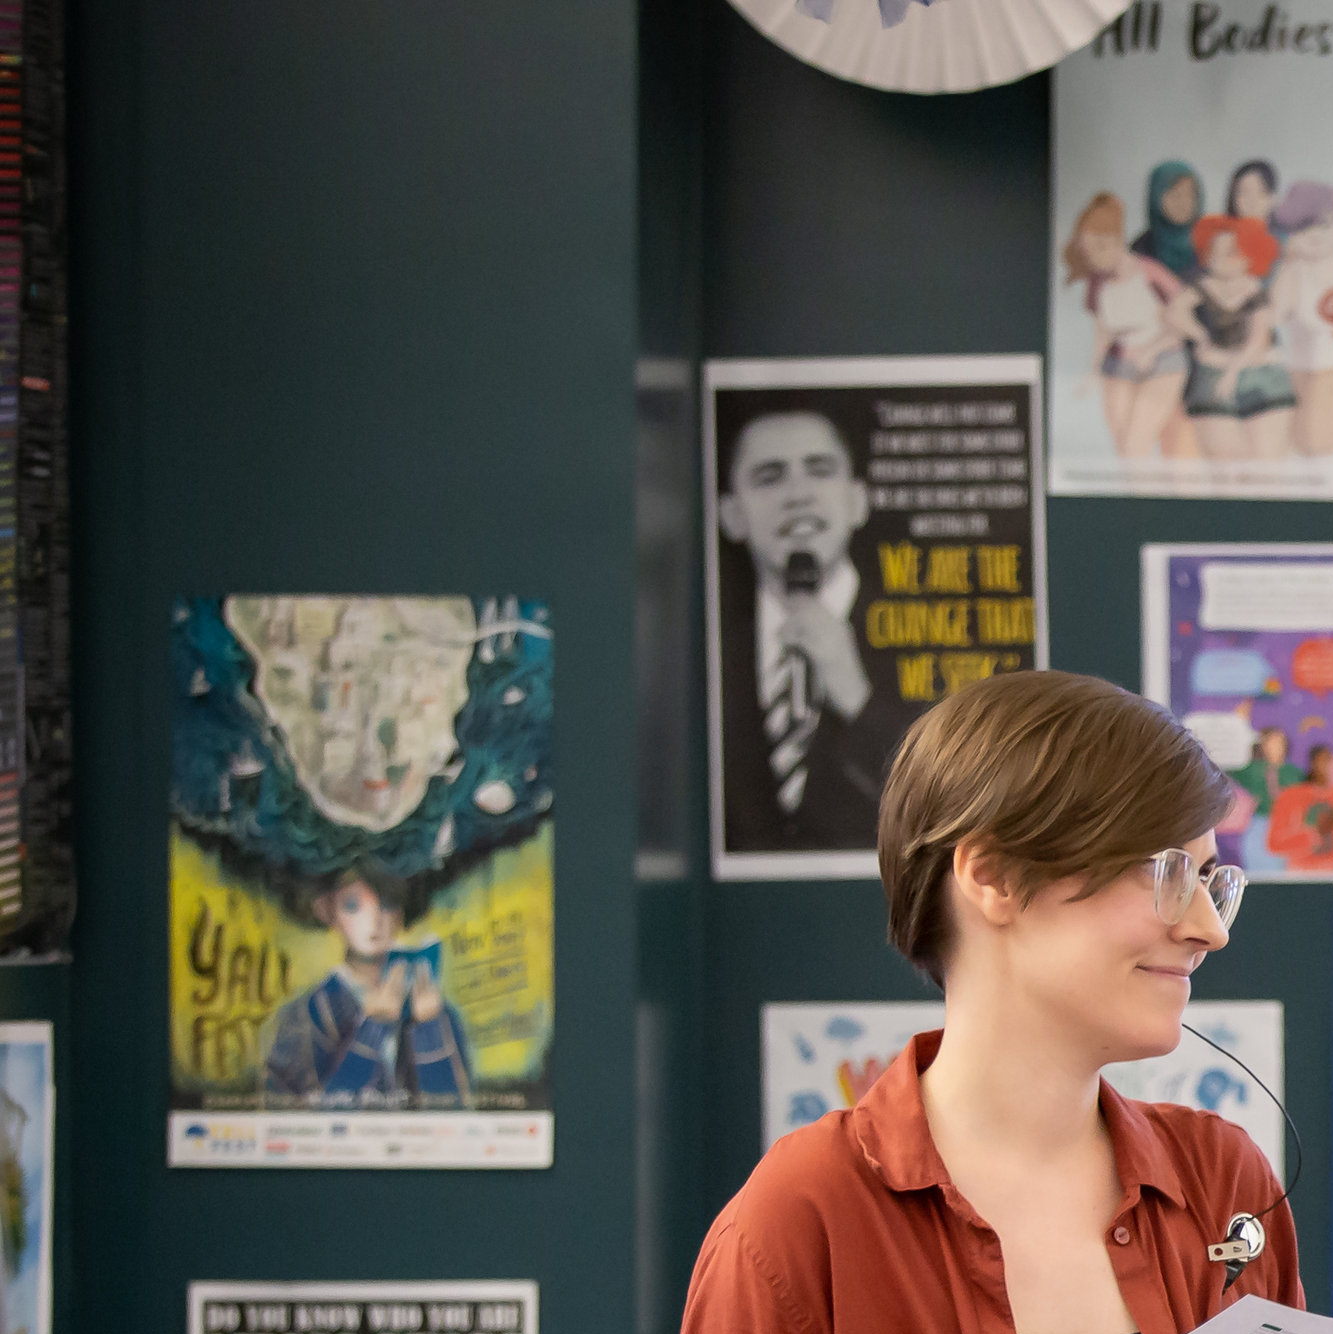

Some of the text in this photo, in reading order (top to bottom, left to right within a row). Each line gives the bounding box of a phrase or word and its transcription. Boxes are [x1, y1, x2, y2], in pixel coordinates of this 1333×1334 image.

[1188, 4, 1333, 61] Bodies
[293, 1304, 363, 1331] KNOW
[365, 1304, 424, 1331] WHO
